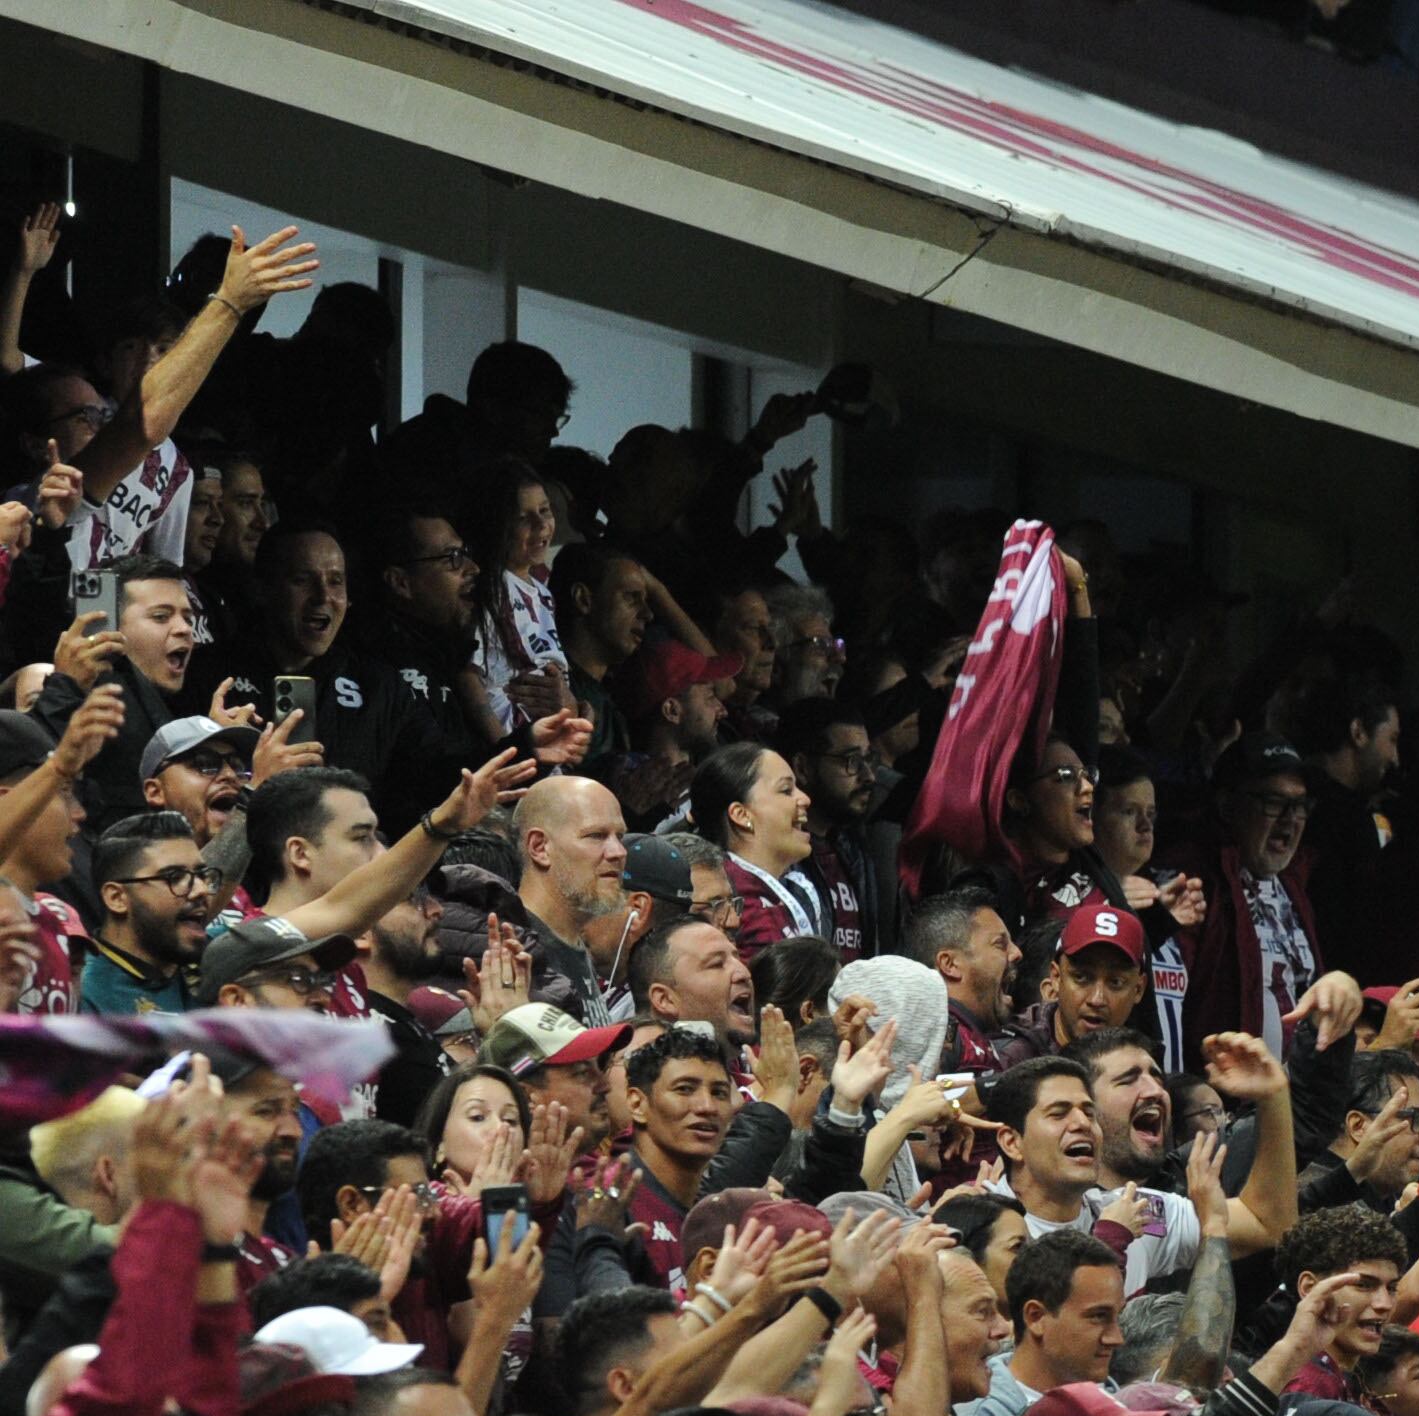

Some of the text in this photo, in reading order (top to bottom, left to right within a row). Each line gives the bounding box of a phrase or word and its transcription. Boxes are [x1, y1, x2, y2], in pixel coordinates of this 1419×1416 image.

[107, 481, 154, 532] BAC
[335, 677, 364, 709] S
[1094, 911, 1119, 937] S
